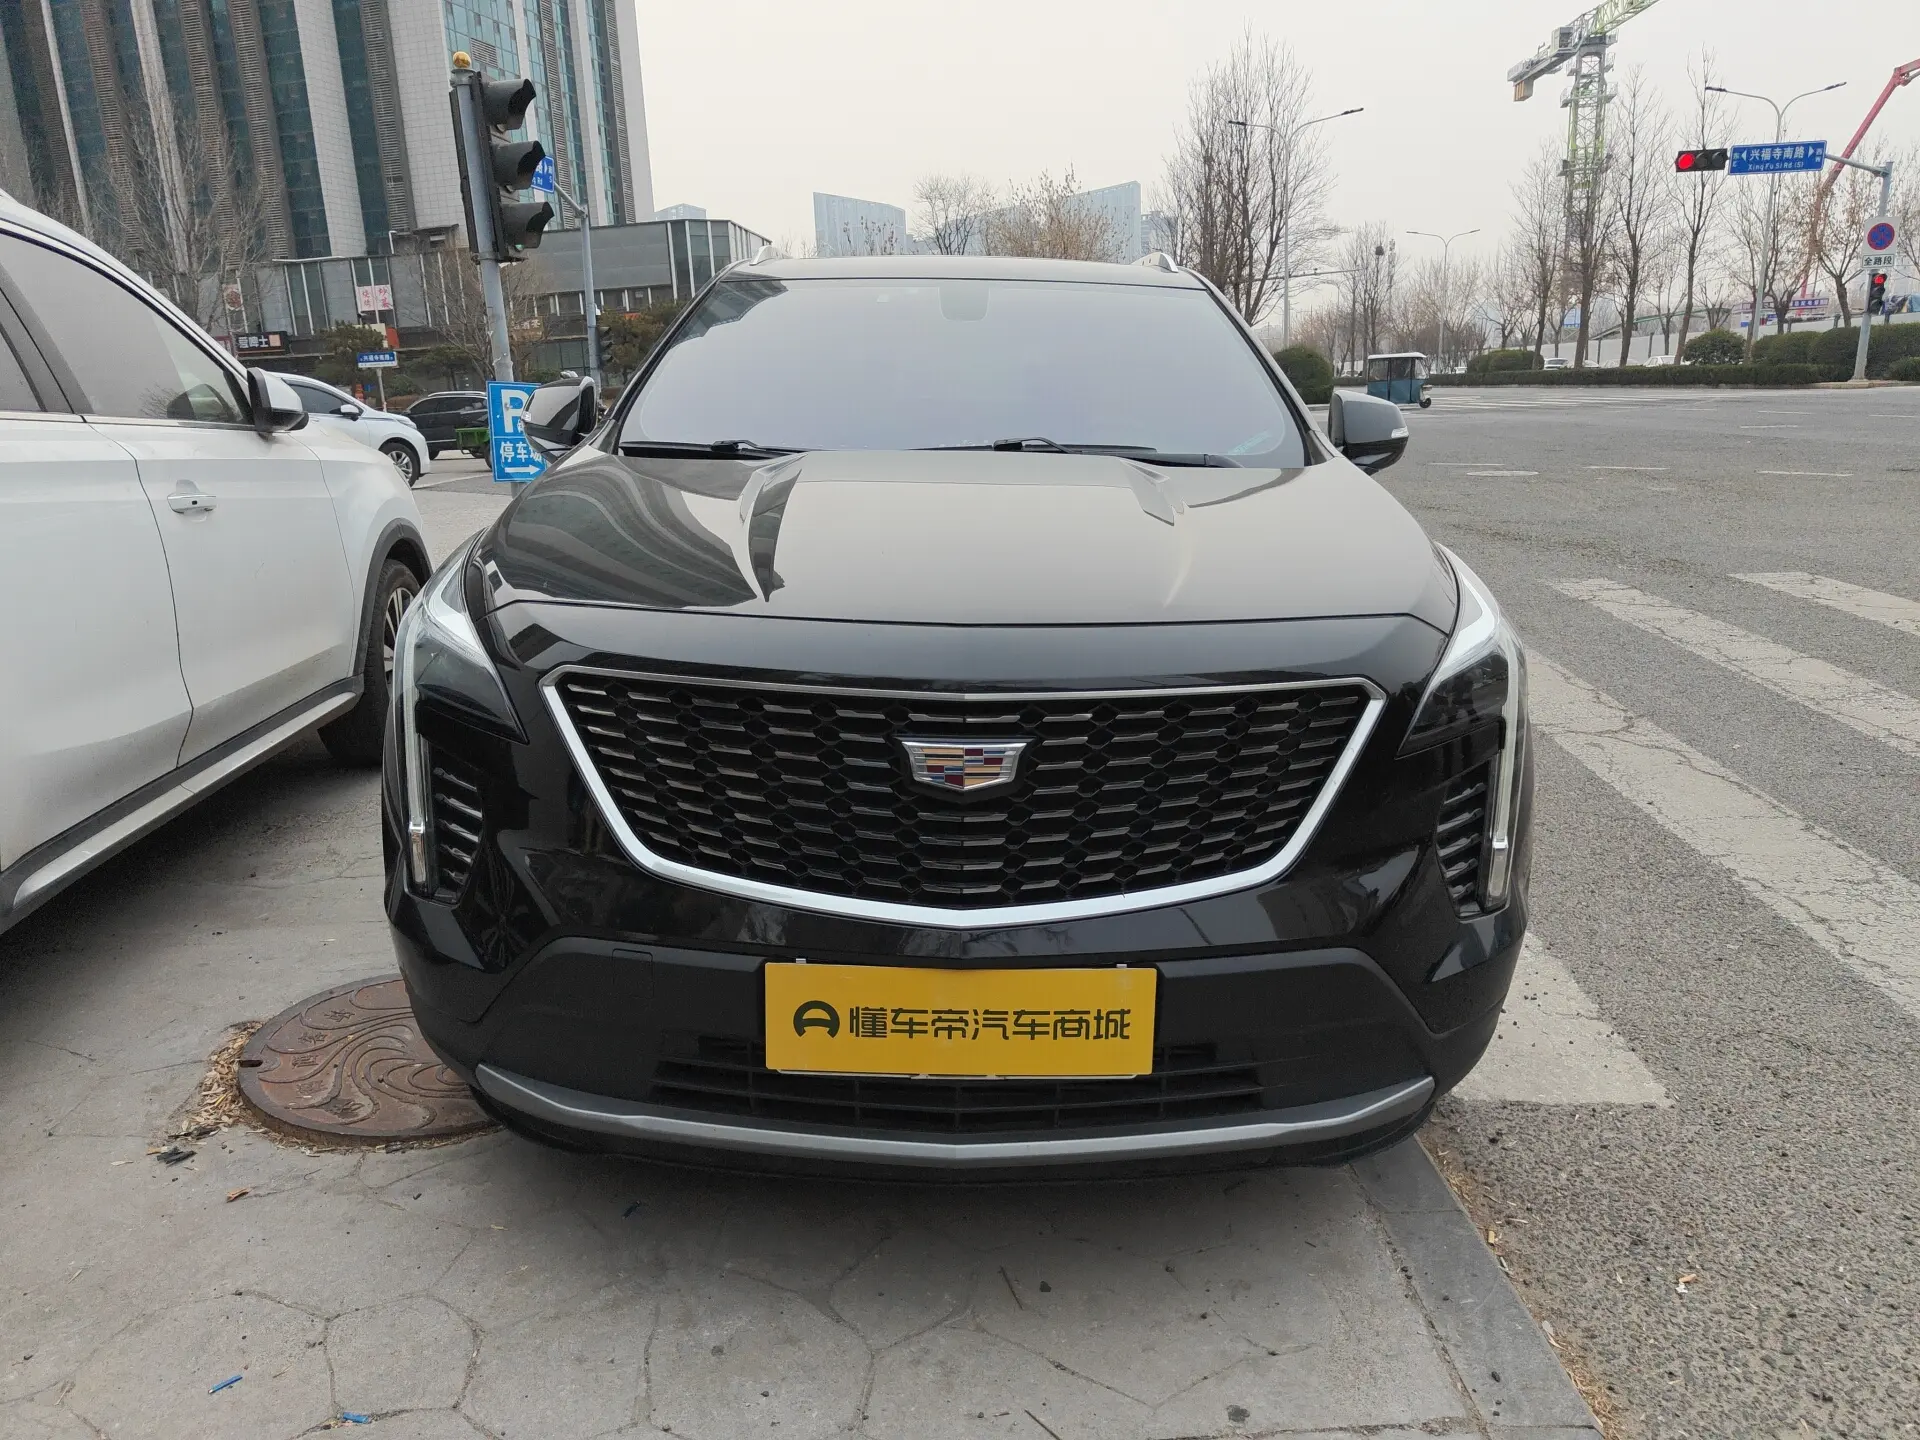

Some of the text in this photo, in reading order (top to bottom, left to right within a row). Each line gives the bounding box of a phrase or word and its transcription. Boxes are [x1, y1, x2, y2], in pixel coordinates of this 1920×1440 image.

[1750, 145, 1804, 161] 兴福寺南路
[1748, 163, 1764, 172] Xing
[1864, 255, 1892, 266] 全路段
[849, 1006, 1132, 1041] 懂车帝汽车商城
